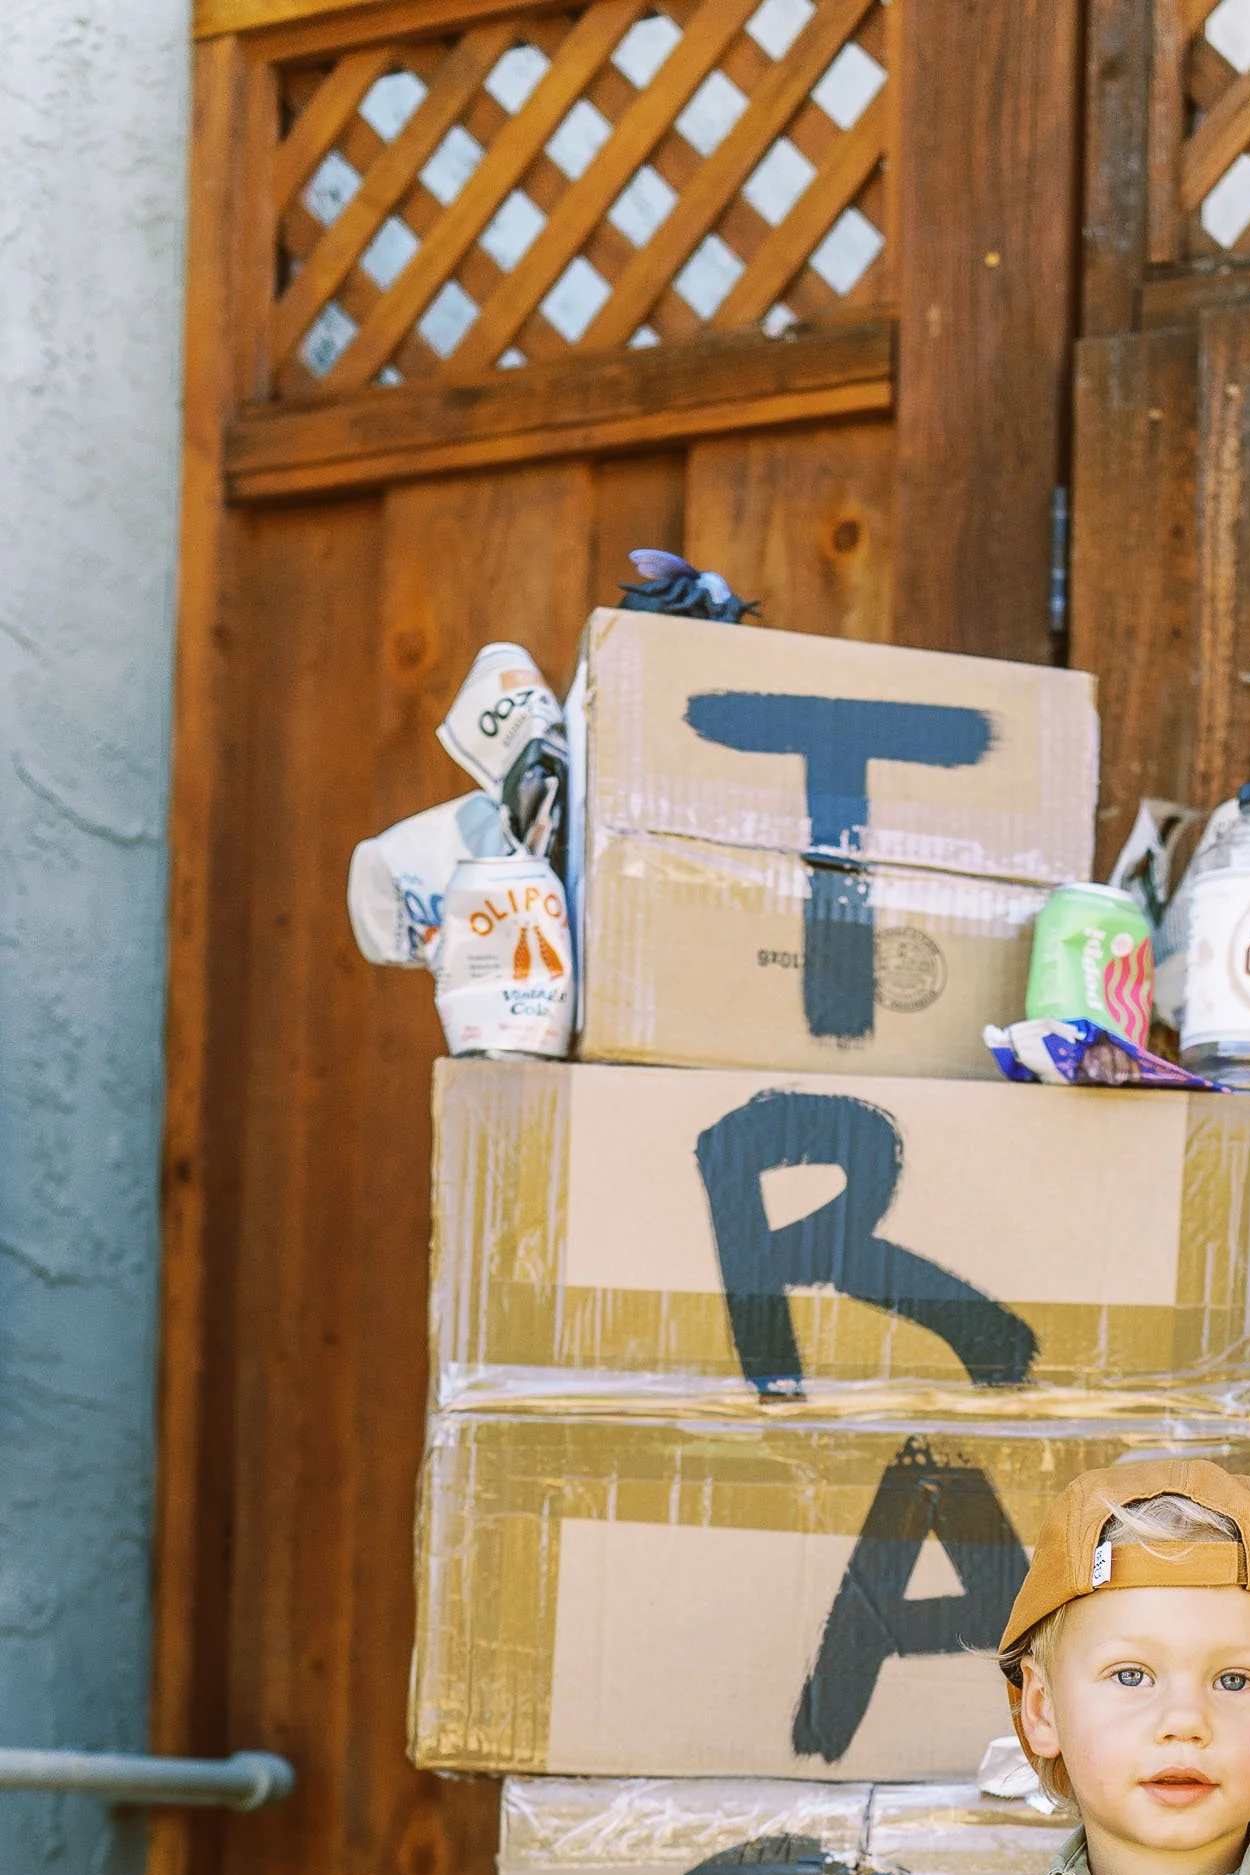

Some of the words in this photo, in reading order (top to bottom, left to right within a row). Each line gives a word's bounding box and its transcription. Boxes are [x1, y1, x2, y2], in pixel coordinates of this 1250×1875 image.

[684, 689, 996, 1048] T
[694, 1087, 1042, 1402] R
[791, 1434, 1035, 1763] A
